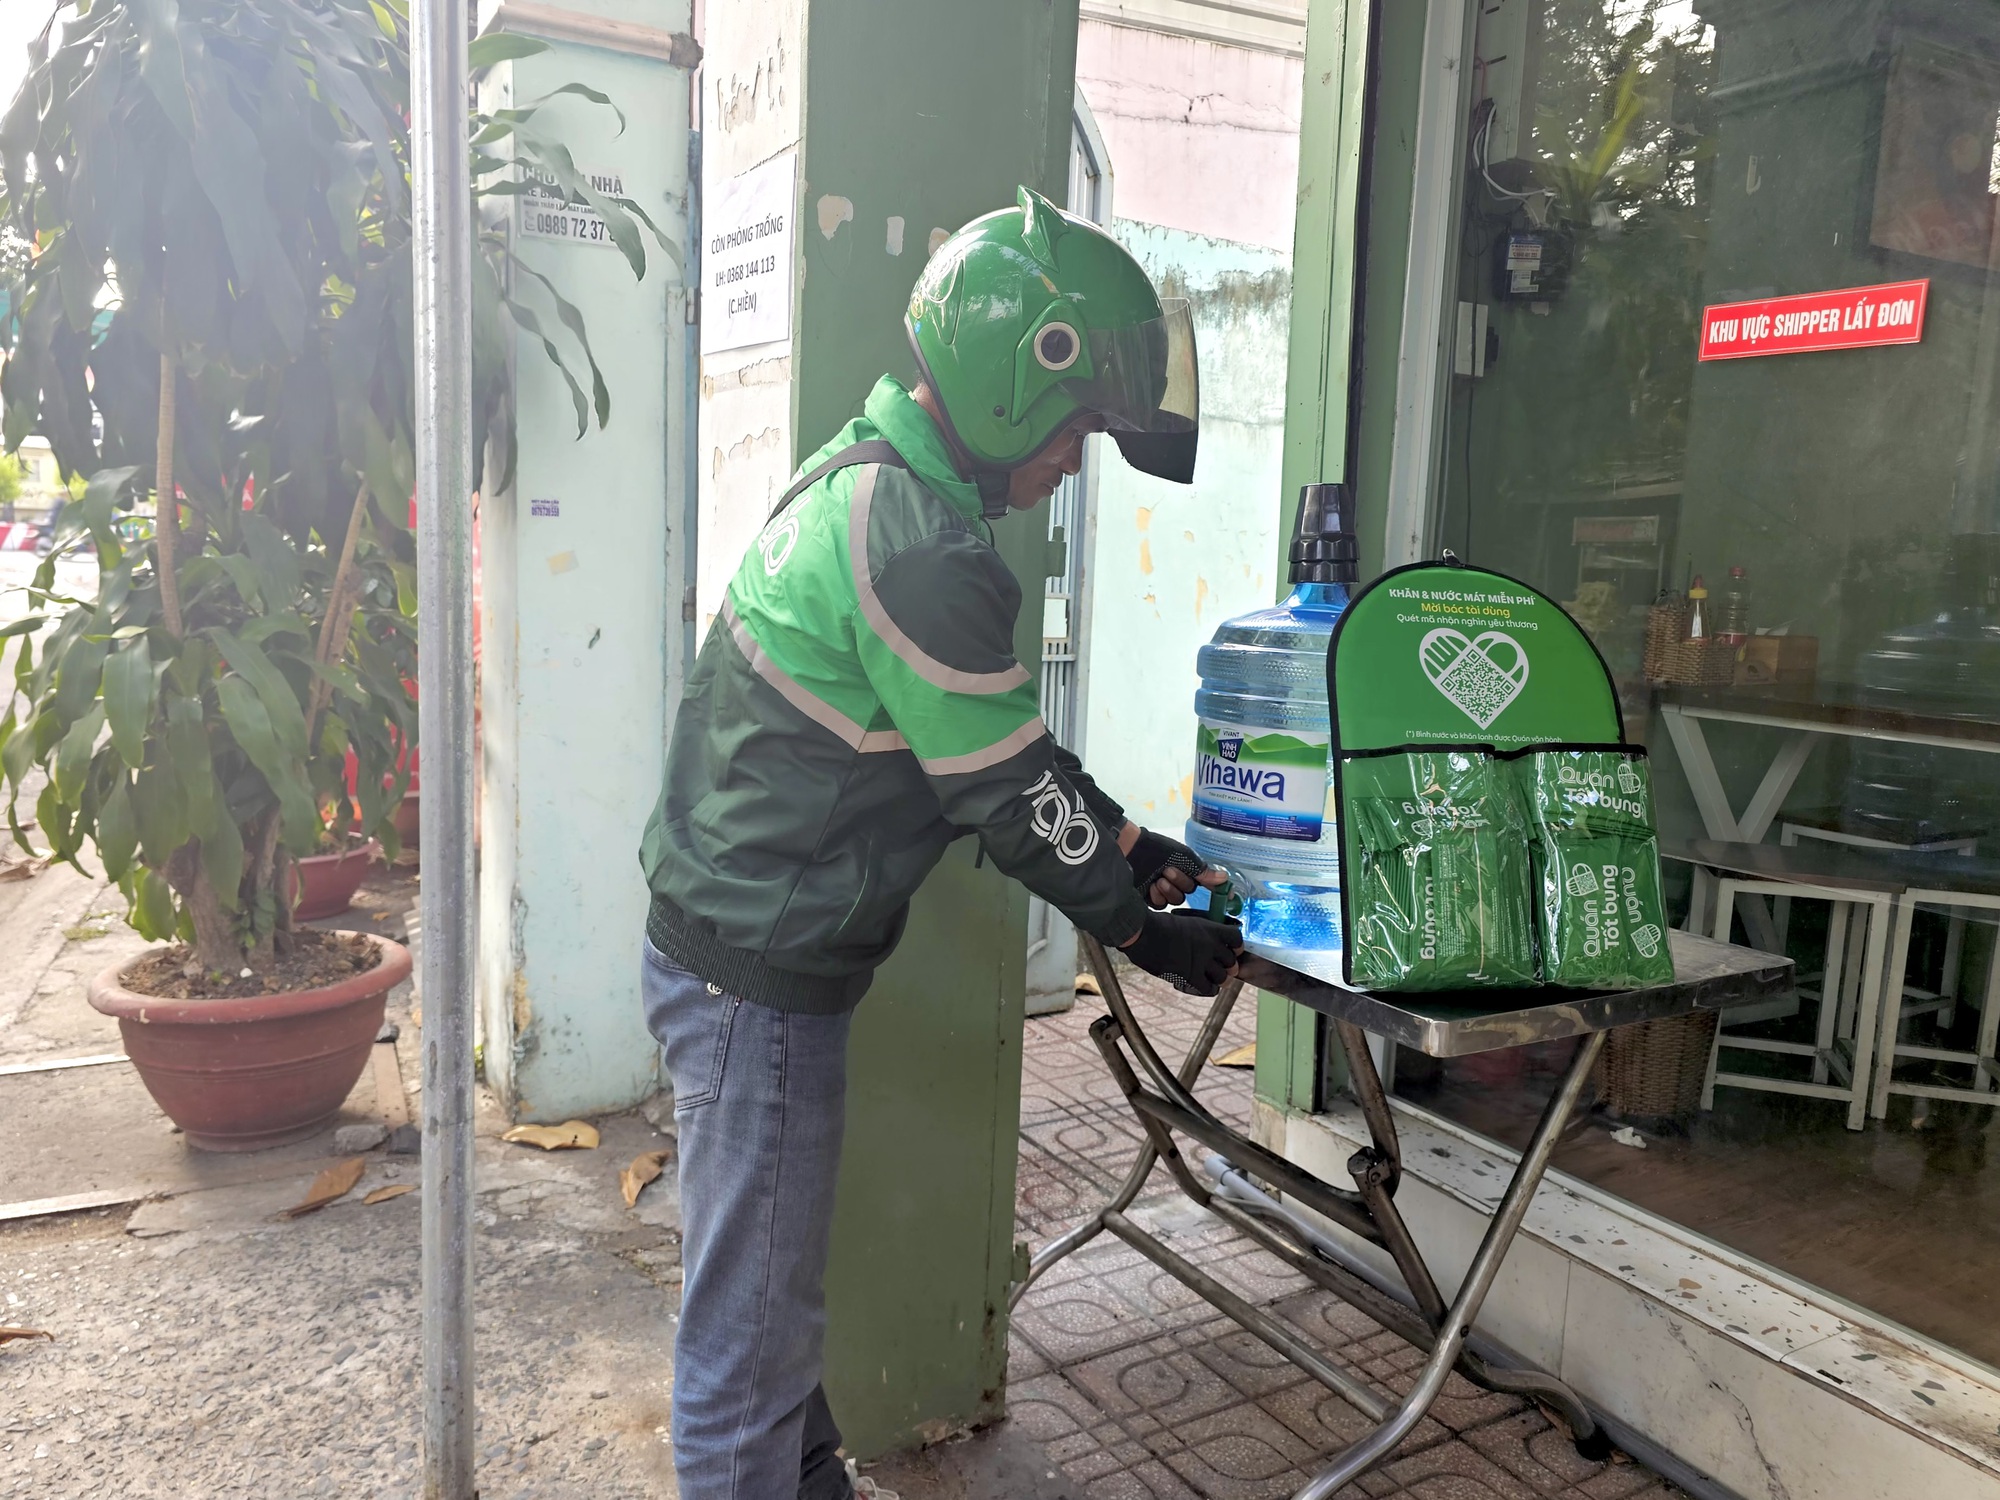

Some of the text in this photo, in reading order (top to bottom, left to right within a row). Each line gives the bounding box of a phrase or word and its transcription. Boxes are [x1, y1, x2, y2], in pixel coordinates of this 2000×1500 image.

[591, 175, 623, 195] NHÀ
[537, 213, 604, 240] 0989 72 37
[711, 212, 784, 254] CÒN PHÒNG TRỐNG
[716, 255, 775, 287] LH: 0368 144 113
[728, 289, 757, 318] (C.HIỀN)
[1708, 296, 1916, 344] KHU VỰC SHIPPER LẤY ĐƠN
[1389, 588, 1420, 599] KHĂN
[1421, 590, 1430, 599] &
[1431, 590, 1462, 601] NƯỚC
[1464, 592, 1486, 603] MÁT
[1488, 591, 1515, 604] MIỄN
[1397, 613, 1538, 630] Quét mã nhận nghìn yêu thương
[1421, 603, 1511, 618] Mời bác tài dùng
[1416, 730, 1431, 738] Bình
[1432, 731, 1449, 739] nước
[1459, 731, 1477, 740] khăn
[1478, 732, 1493, 741] lạnh
[1494, 733, 1511, 742] được
[1512, 734, 1531, 743] Quán
[1198, 752, 1285, 801] Vihawa
[1559, 766, 1614, 790] Quán
[1601, 791, 1642, 818] bụng
[1601, 864, 1620, 950] Tốt bụng
[1622, 867, 1643, 923] Quán
[1583, 900, 1601, 957] Quán
